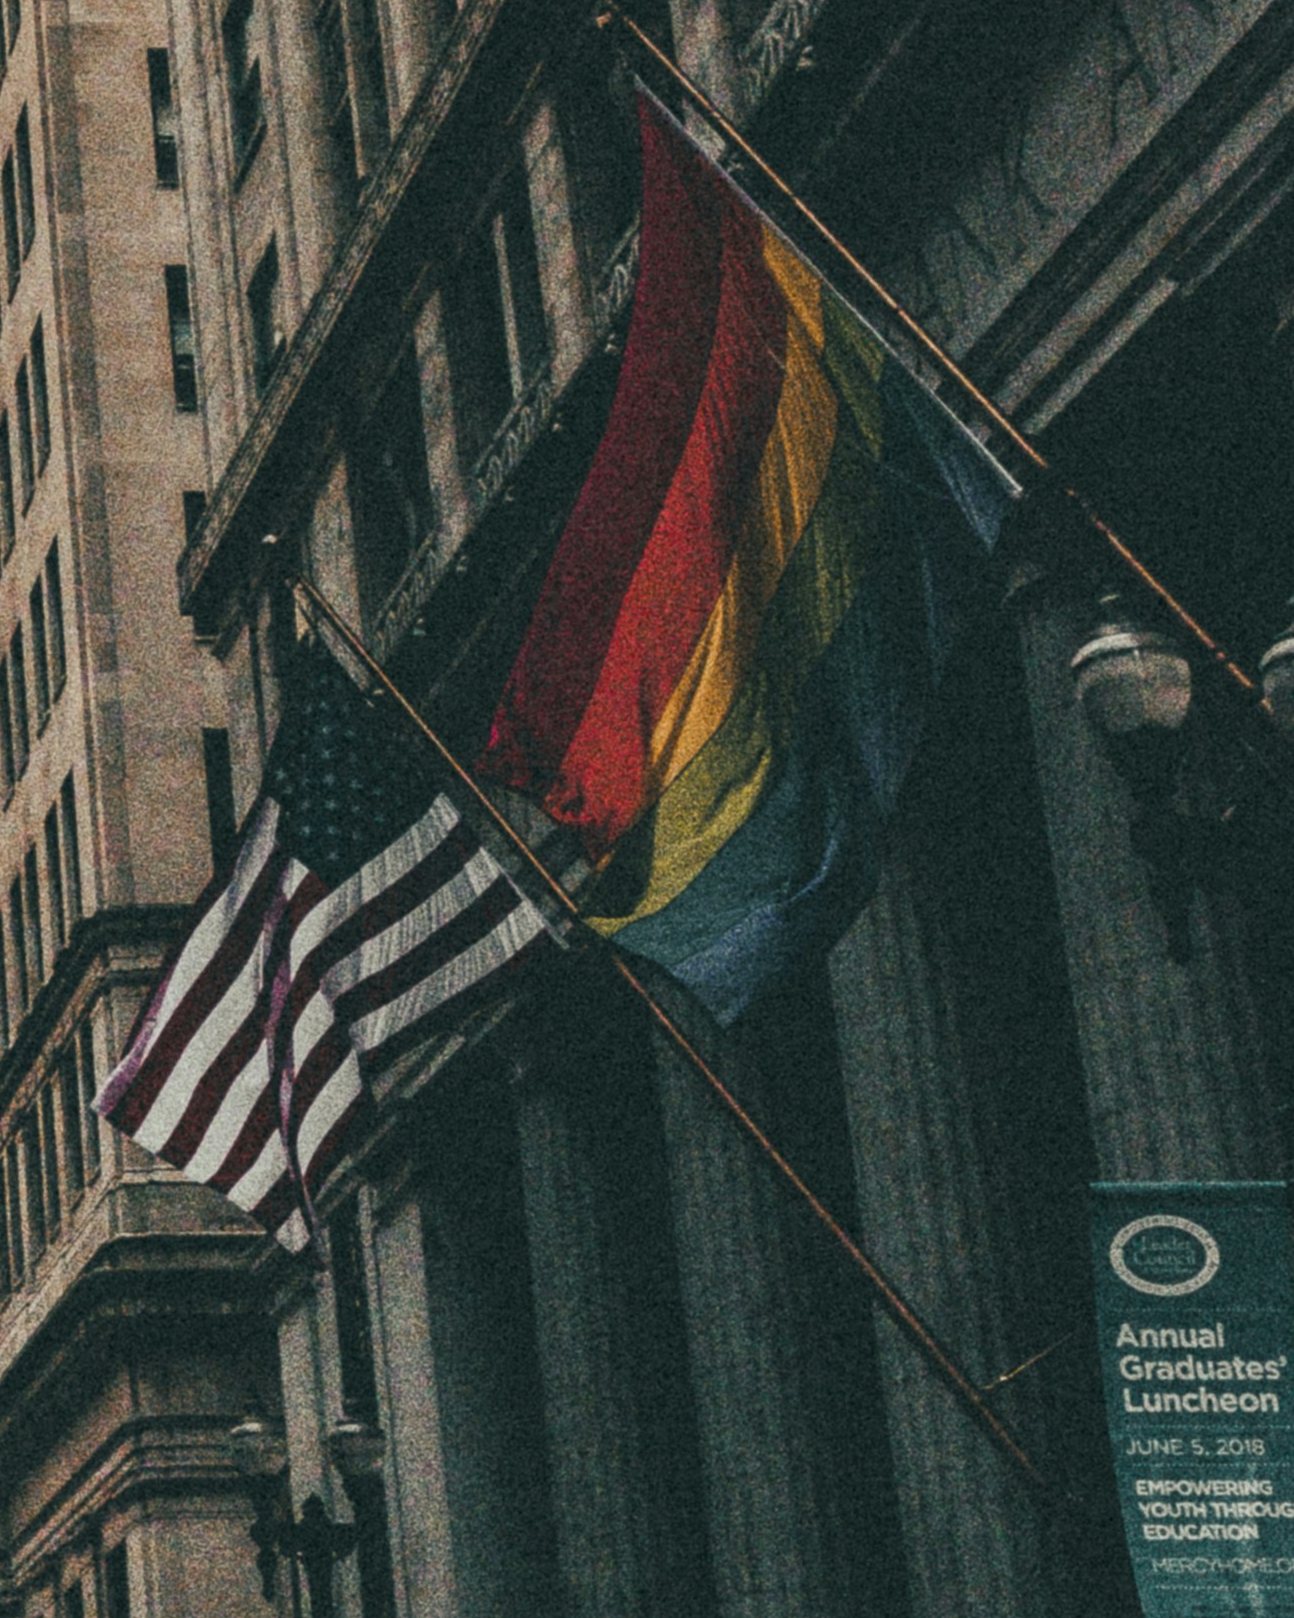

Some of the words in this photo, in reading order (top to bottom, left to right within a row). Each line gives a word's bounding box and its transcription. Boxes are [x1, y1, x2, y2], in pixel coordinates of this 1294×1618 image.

[1115, 1321, 1225, 1349] Annual
[1118, 1354, 1288, 1381] Graduates'
[1122, 1385, 1280, 1414] Luncheon
[1125, 1438, 1183, 1456] JUNE
[1216, 1438, 1265, 1456] 2018
[1134, 1478, 1273, 1496] EMPOWERING
[1138, 1500, 1206, 1519] YOUTH
[1141, 1522, 1260, 1541] EDUCATION
[1151, 1556, 1294, 1574] MERCYHOME.O
